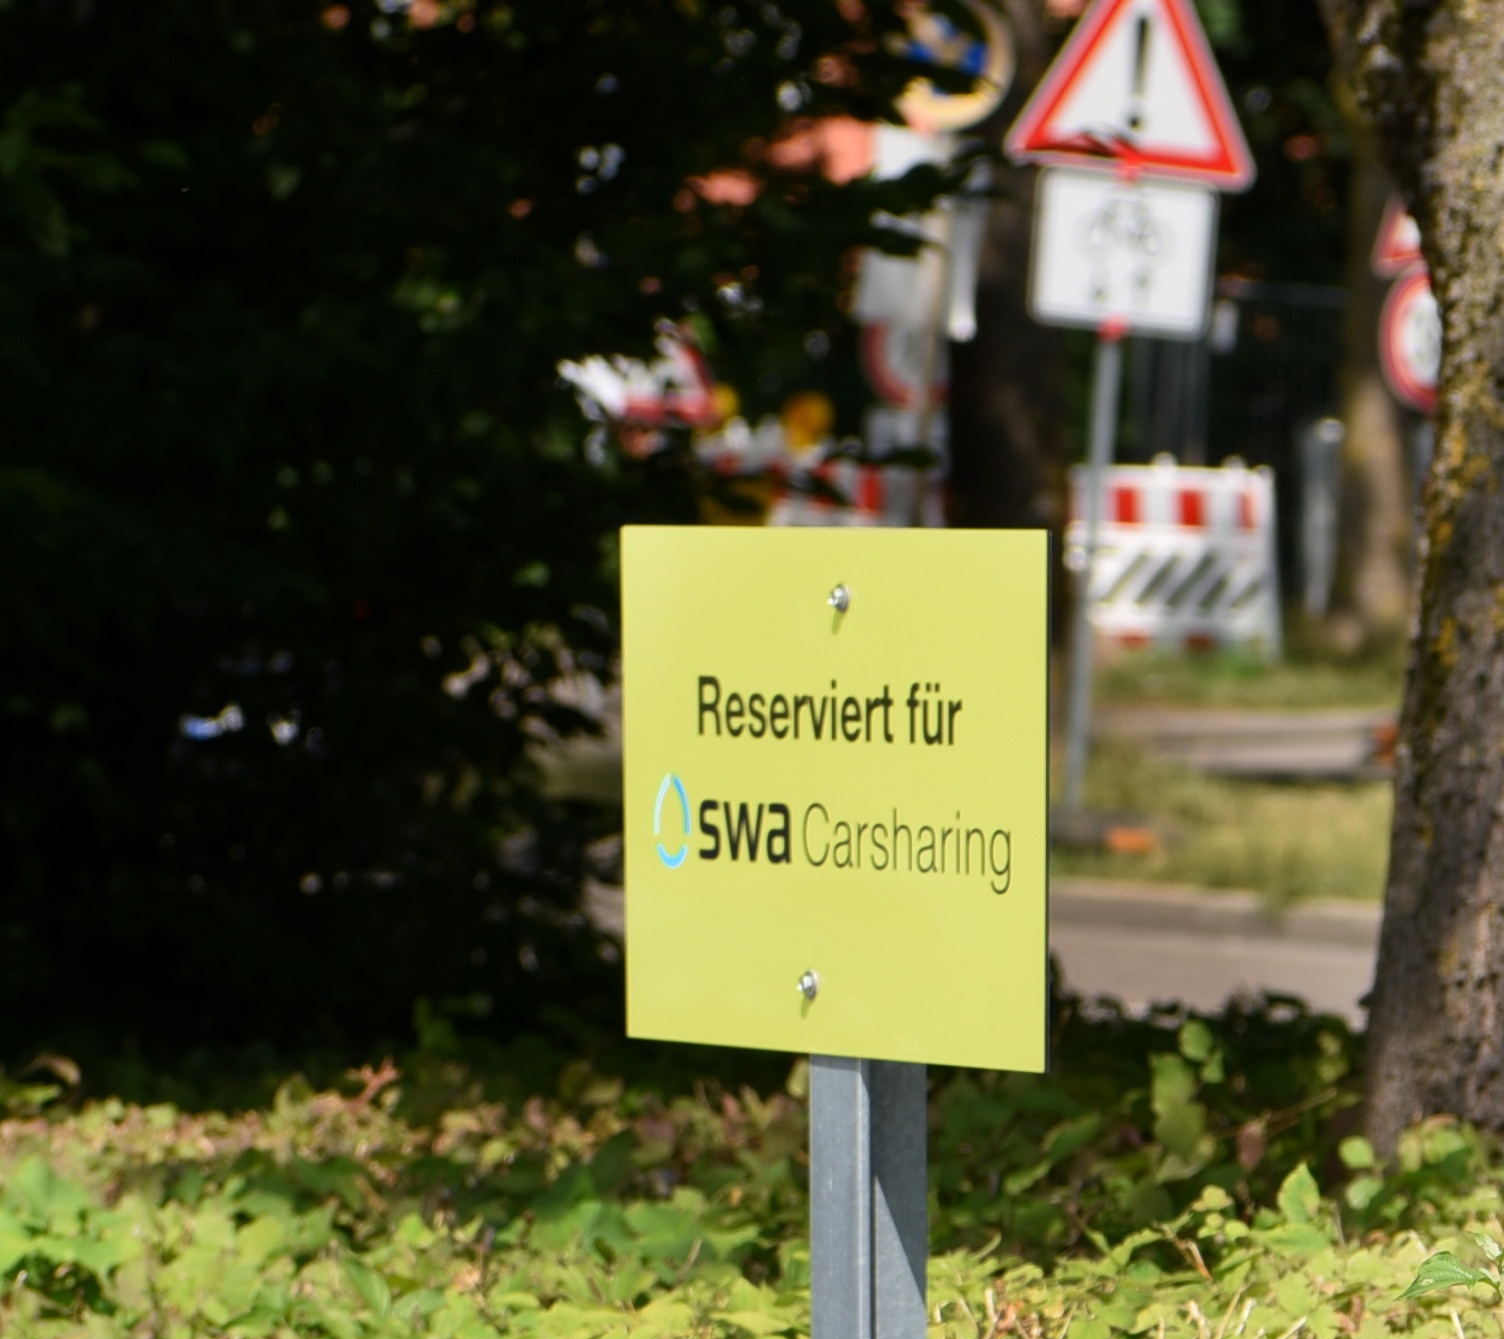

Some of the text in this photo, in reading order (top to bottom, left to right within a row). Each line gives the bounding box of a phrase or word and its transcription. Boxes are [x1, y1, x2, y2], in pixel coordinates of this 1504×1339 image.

[696, 675, 964, 746] Reserviert für
[698, 798, 1013, 895] swa Carsharing
